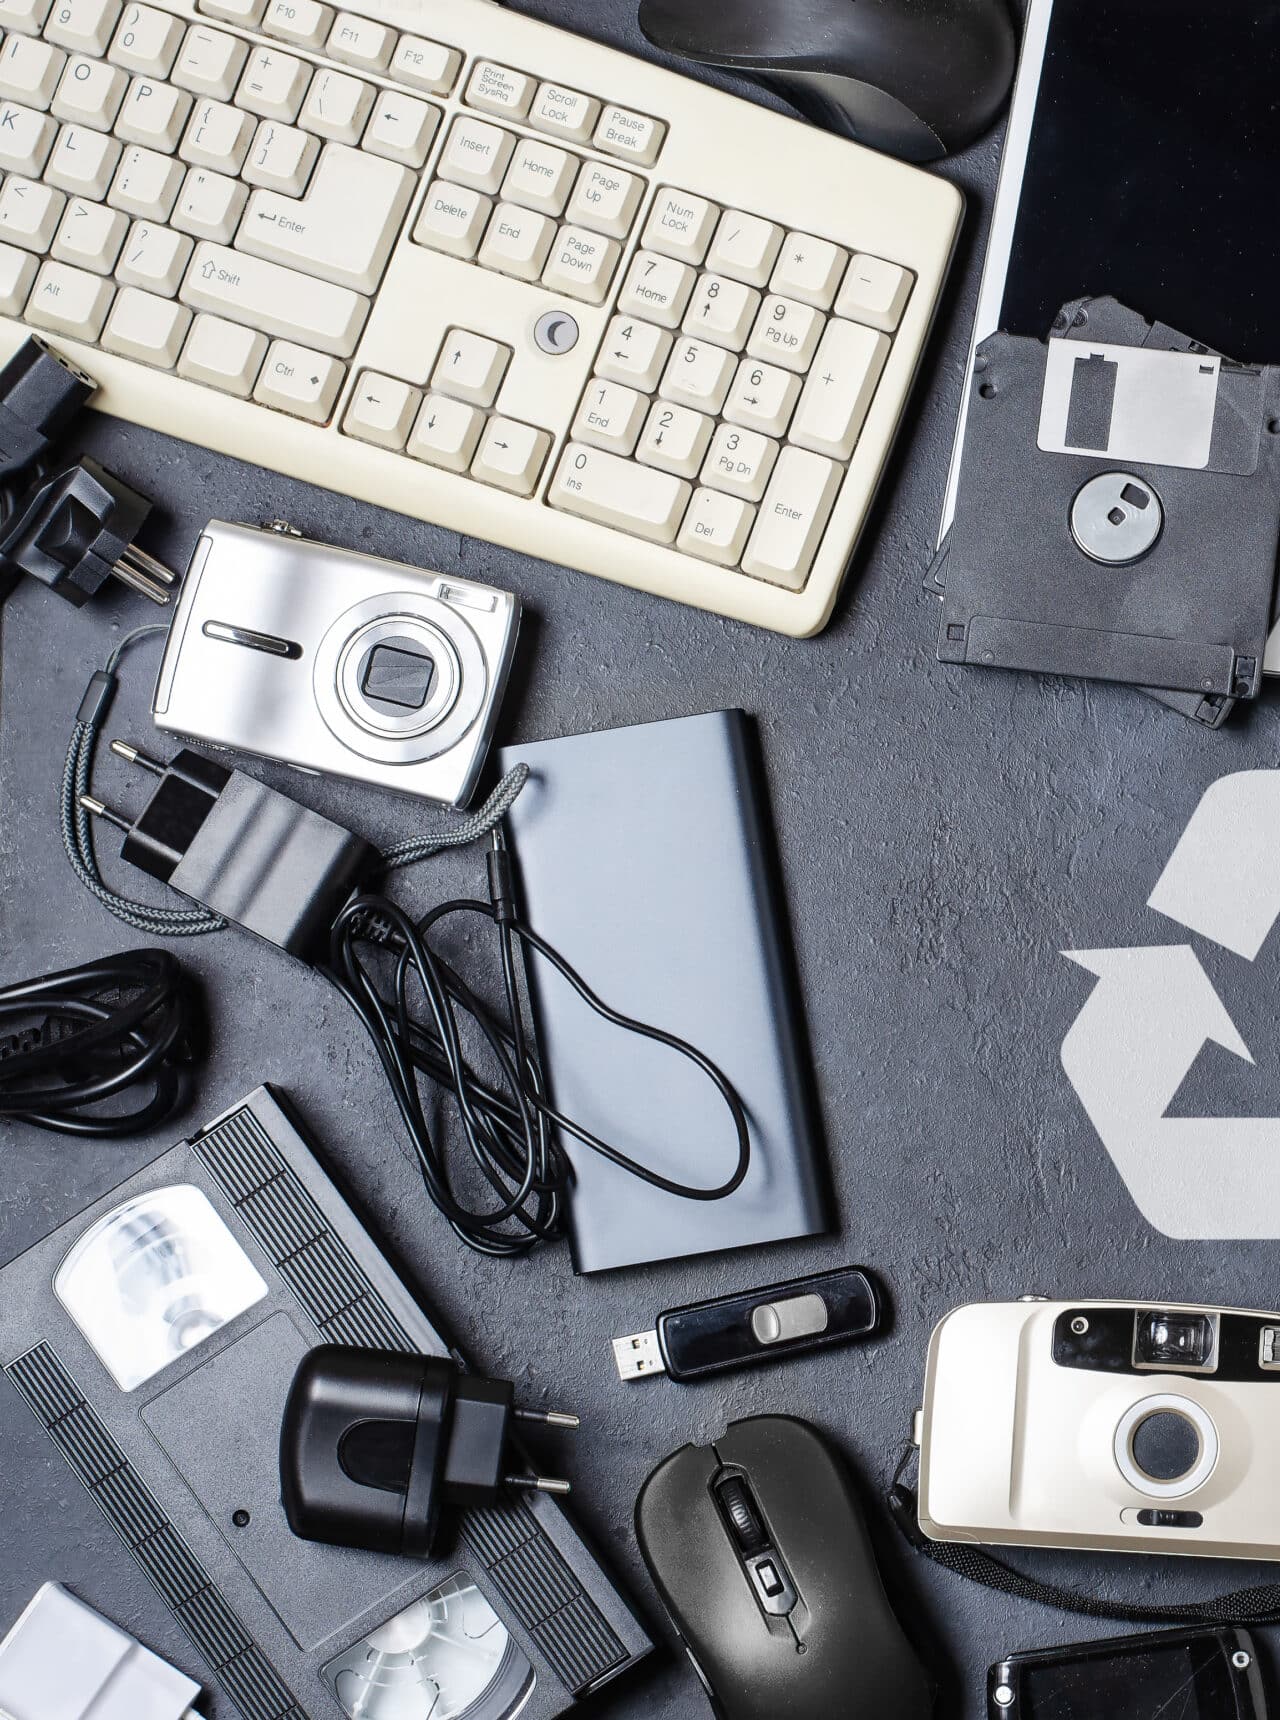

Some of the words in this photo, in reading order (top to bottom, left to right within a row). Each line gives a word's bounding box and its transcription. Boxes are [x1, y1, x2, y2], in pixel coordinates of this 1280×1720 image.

[59, 9, 71, 23] 9
[131, 9, 140, 25] )
[276, 4, 296, 19] F10
[123, 32, 135, 47] 0
[340, 27, 360, 43] F11
[260, 56, 272, 69] +
[403, 50, 424, 65] F12
[74, 63, 91, 81] O
[483, 66, 505, 81] Print
[250, 82, 263, 91] =
[481, 75, 515, 92] Screen
[136, 84, 153, 102] P
[478, 83, 509, 102] SysRq
[546, 89, 578, 108] Scroll
[1, 109, 20, 130] K
[541, 104, 568, 122] Lock
[611, 112, 646, 132] Pause
[66, 131, 76, 151] L
[459, 136, 490, 155] Insert
[605, 128, 637, 148] Break
[522, 158, 554, 178] Home
[592, 172, 620, 191] Page
[586, 188, 601, 202] Up
[434, 200, 468, 219] Delete
[666, 201, 694, 220] Num
[277, 216, 306, 233] Enter
[498, 223, 521, 239] End
[661, 215, 688, 232] Lock
[141, 229, 149, 239] ?
[567, 236, 596, 255] Page
[560, 253, 592, 270] Down
[645, 261, 657, 276] 7
[217, 269, 241, 286] Shift
[43, 283, 61, 296] Alt
[635, 285, 667, 304] Home
[707, 282, 720, 298] 8
[772, 304, 786, 321] 9
[621, 326, 633, 340] 4
[765, 327, 781, 342] Pg
[782, 332, 798, 346] Up
[684, 346, 698, 363] 5
[275, 362, 295, 377] Ctrl
[750, 370, 764, 386] 6
[822, 373, 835, 385] +
[598, 389, 606, 405] 1
[587, 412, 610, 427] End
[659, 411, 674, 428] 2
[726, 434, 740, 450] 3
[574, 453, 587, 470] 0
[719, 456, 734, 472] Pg
[736, 461, 752, 475] Dn
[566, 476, 583, 491] Ins
[774, 502, 803, 521] Enter
[695, 522, 715, 537] Del
